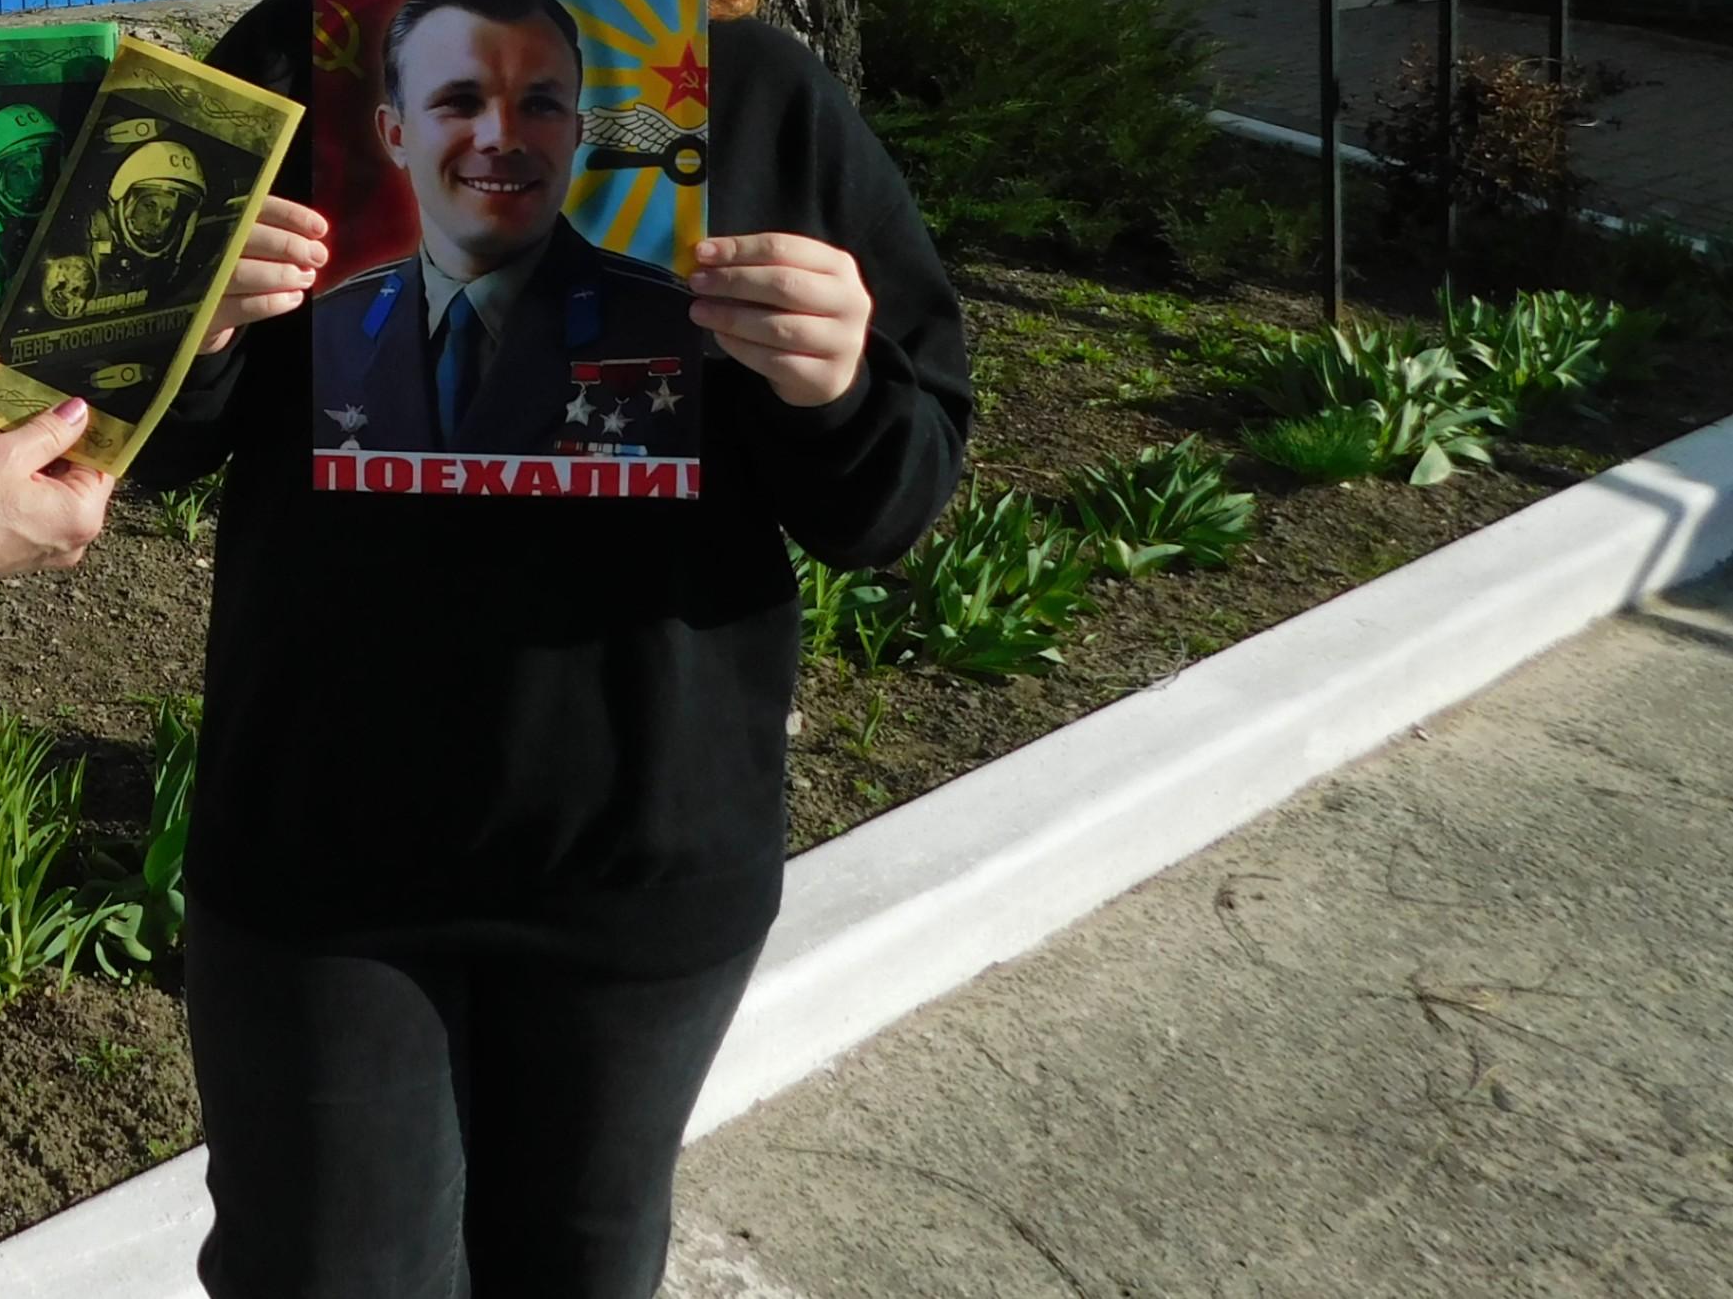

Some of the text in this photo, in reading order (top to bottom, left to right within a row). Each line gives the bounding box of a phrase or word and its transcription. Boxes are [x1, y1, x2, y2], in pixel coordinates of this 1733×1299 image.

[11, 310, 189, 364] ДЕНЬ КОСМОНАВТИКИ
[313, 454, 700, 499] ПОЕХАЛИ!
